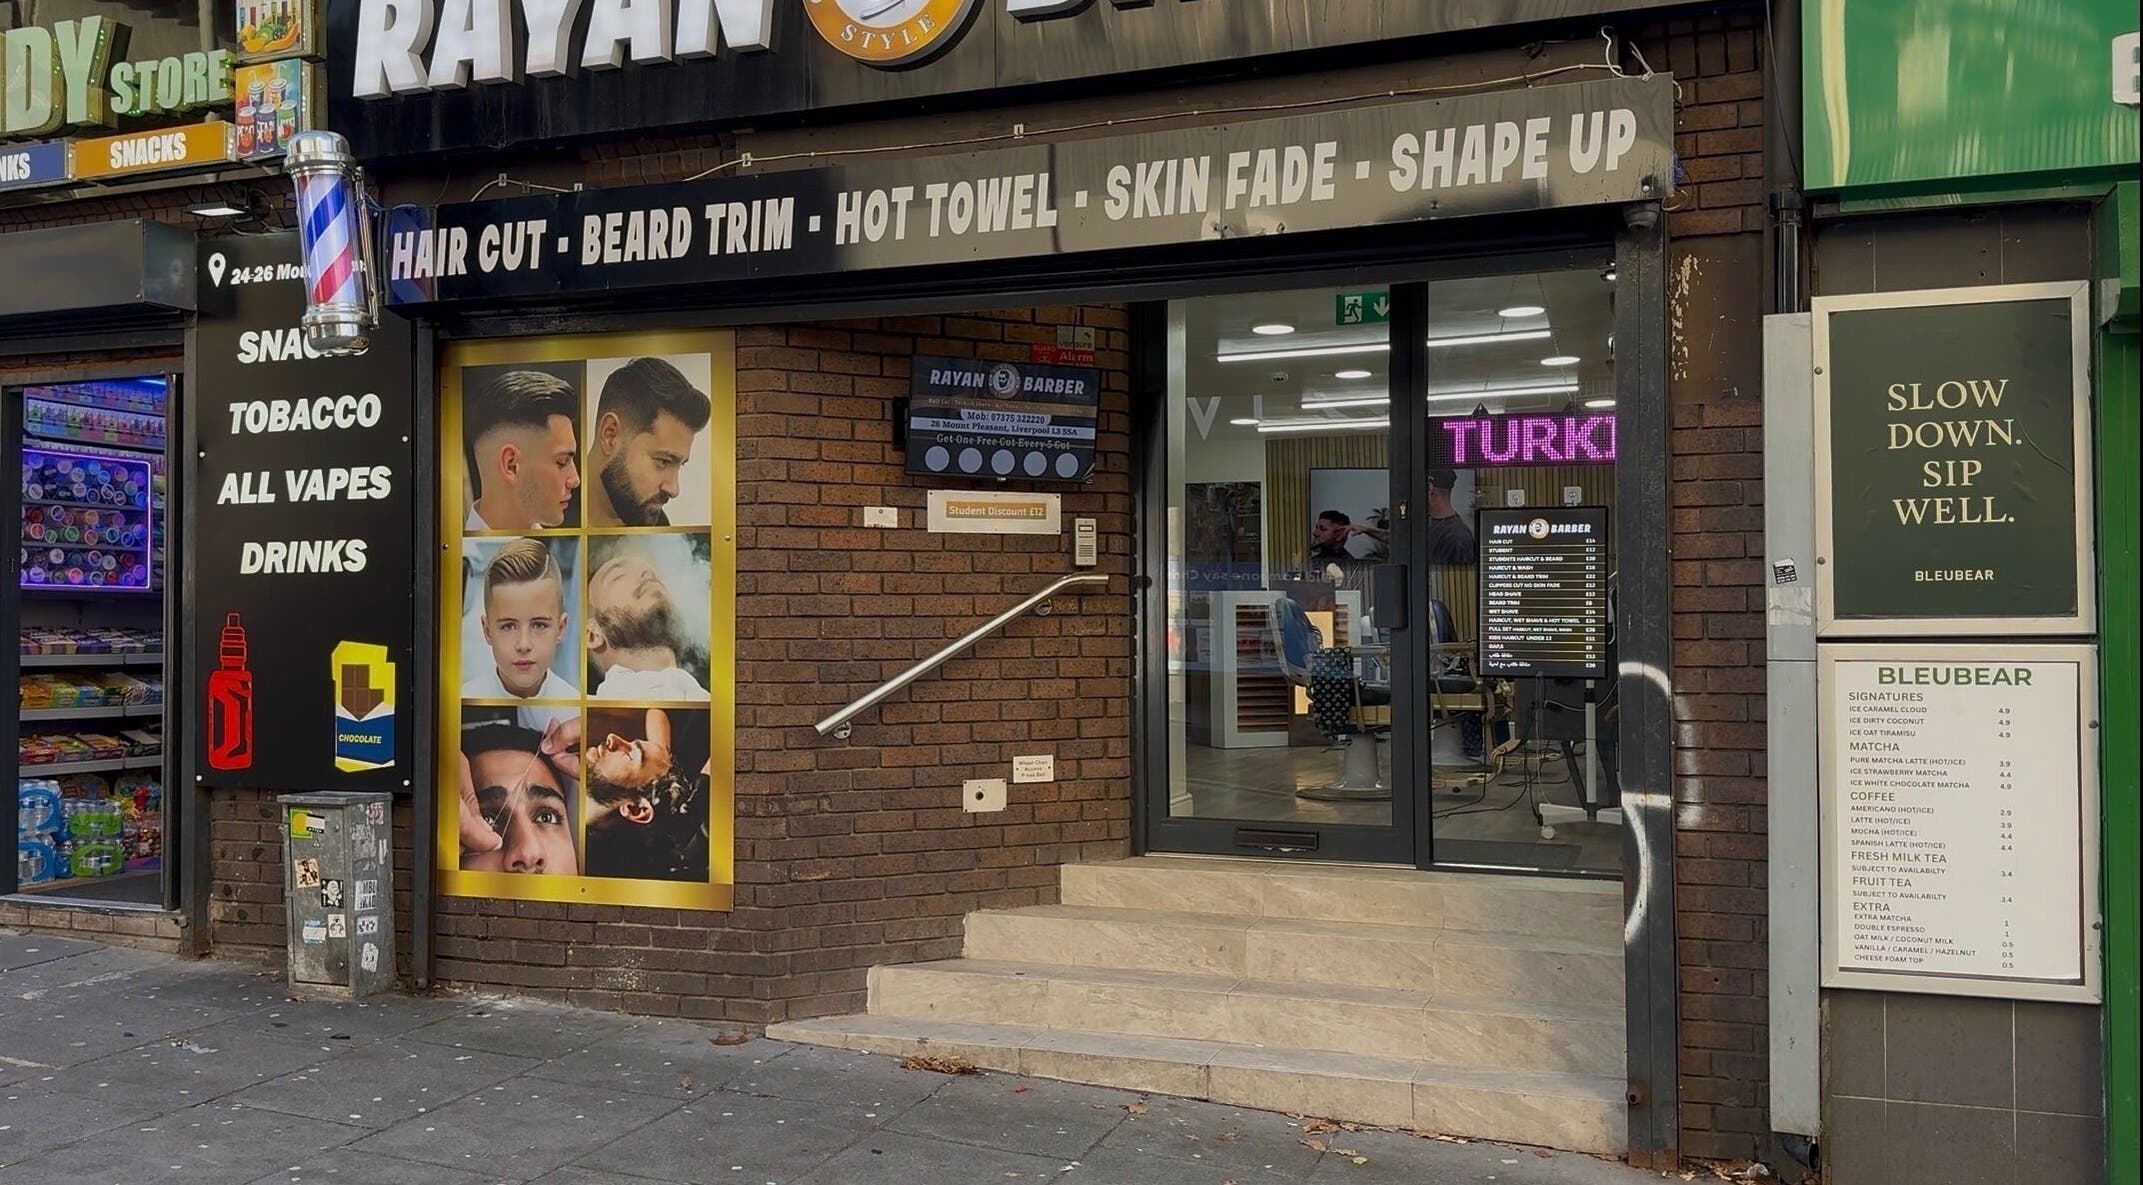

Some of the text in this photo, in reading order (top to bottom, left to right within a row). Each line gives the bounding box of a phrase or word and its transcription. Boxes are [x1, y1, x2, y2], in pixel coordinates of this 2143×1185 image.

[841, 14, 936, 50] STYLE
[111, 49, 229, 115] STORE
[110, 132, 187, 169] SNACKS
[391, 108, 1637, 281] HAIR CUT BEARD TRIM HOT TOWEL SKIN FADE SHAPE UP
[230, 263, 311, 285] 24-26 Mou
[237, 328, 369, 363] SNAC
[929, 369, 1085, 395] RAYAN BARBER
[1888, 379, 2008, 412] SLOW
[229, 393, 382, 434] TOBACCO
[941, 421, 969, 430] Mount
[972, 423, 1010, 433] Pleasant,
[1011, 425, 1050, 436] Liverpool
[1888, 419, 2022, 450] DOWN.
[217, 466, 392, 505] ALL VAPES
[1923, 460, 1982, 487] SIP
[949, 505, 1044, 516] Student Discount £12
[1892, 496, 2015, 525] WELL.
[1493, 524, 1591, 534] RAYAN BARBER
[240, 539, 368, 574] DRINKS
[1915, 570, 1994, 581] BLEUBEAR
[1878, 667, 2032, 686] BLEUBEAR
[1849, 692, 1923, 702] SIGNATURES
[338, 733, 382, 744] CHOCOLATE
[1850, 742, 1900, 752] MATCHA
[1850, 792, 1895, 801] COFFEE
[1852, 851, 1947, 863] FRESH MILK TEA
[1853, 877, 1912, 887] FRUIT TEA
[1853, 902, 1890, 912] EXTRA
